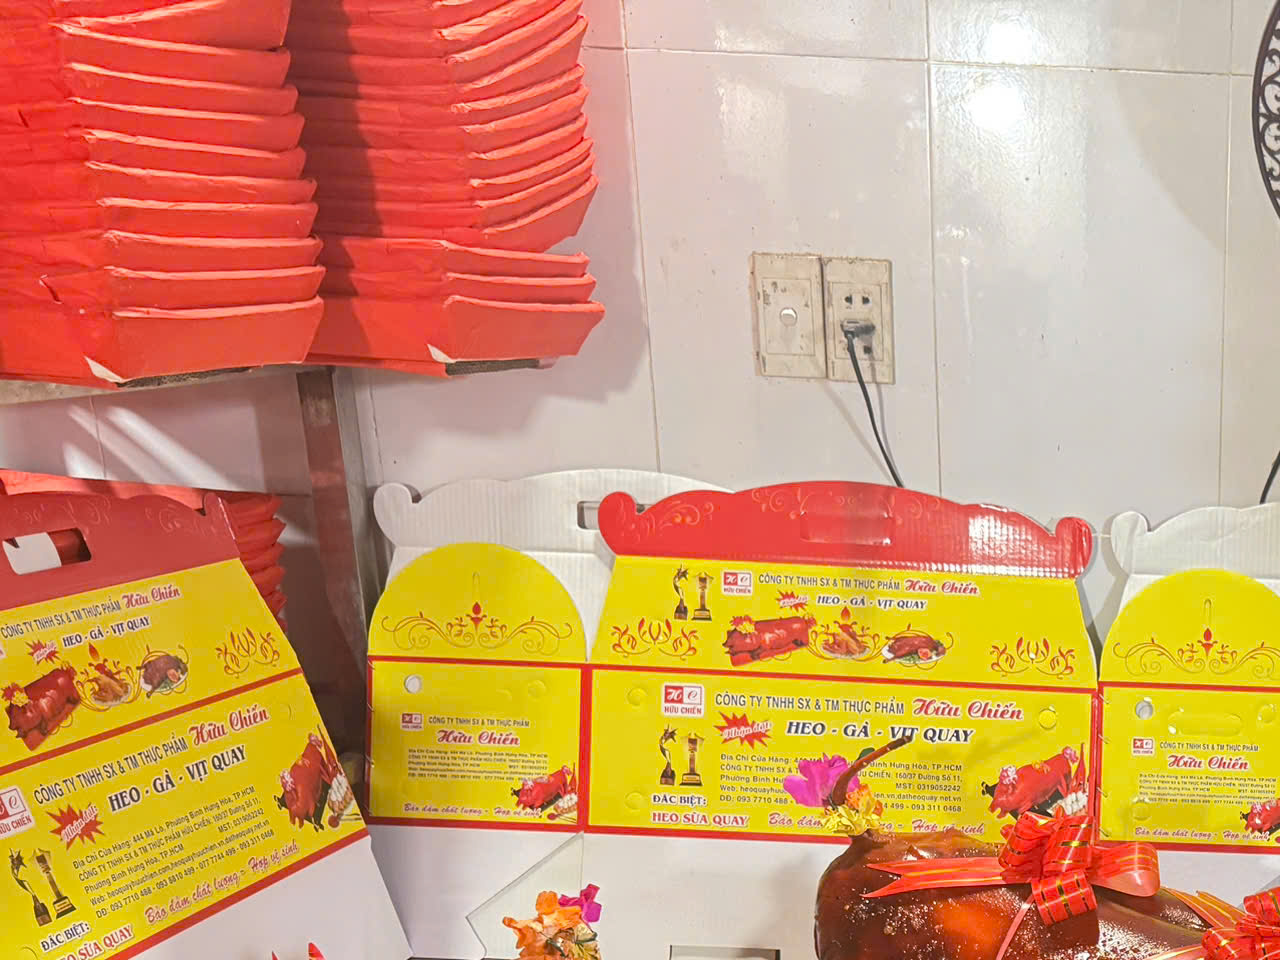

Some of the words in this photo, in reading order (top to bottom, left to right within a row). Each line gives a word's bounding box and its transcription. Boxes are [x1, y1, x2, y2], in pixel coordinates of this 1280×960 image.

[62, 633, 82, 647] HEO
[90, 626, 104, 639] GÀ
[111, 622, 125, 637] VỊT
[127, 617, 151, 631] QUAY
[715, 692, 746, 707] CÔNG
[750, 695, 762, 707] TY
[766, 696, 794, 709] TNHH
[797, 697, 812, 709] SX
[826, 699, 839, 711] TM
[843, 699, 871, 714] THỰC
[875, 696, 904, 714] PHẨM
[913, 698, 961, 717] Hữu
[968, 700, 1023, 720] Chiến
[787, 721, 825, 735] HEO
[843, 721, 870, 738] GÀ
[924, 727, 973, 742] QUAY
[34, 784, 63, 804] CÔNG
[62, 777, 76, 793] TY
[76, 766, 104, 787] TNHH
[103, 764, 117, 779] SX
[124, 755, 139, 771] TM
[138, 746, 164, 764] THỰC
[162, 732, 188, 757] PHẨM
[189, 721, 227, 745] Hữu
[229, 705, 269, 731] Chiến
[108, 786, 141, 812] HEO
[153, 770, 176, 794] GÀ
[186, 760, 208, 782] VỊT
[212, 745, 246, 771] QUAY
[653, 813, 679, 823] HEO
[683, 812, 708, 824] SỮA
[713, 814, 748, 826] QUAY
[78, 941, 102, 960] SỮA
[104, 926, 133, 948] QUAY
